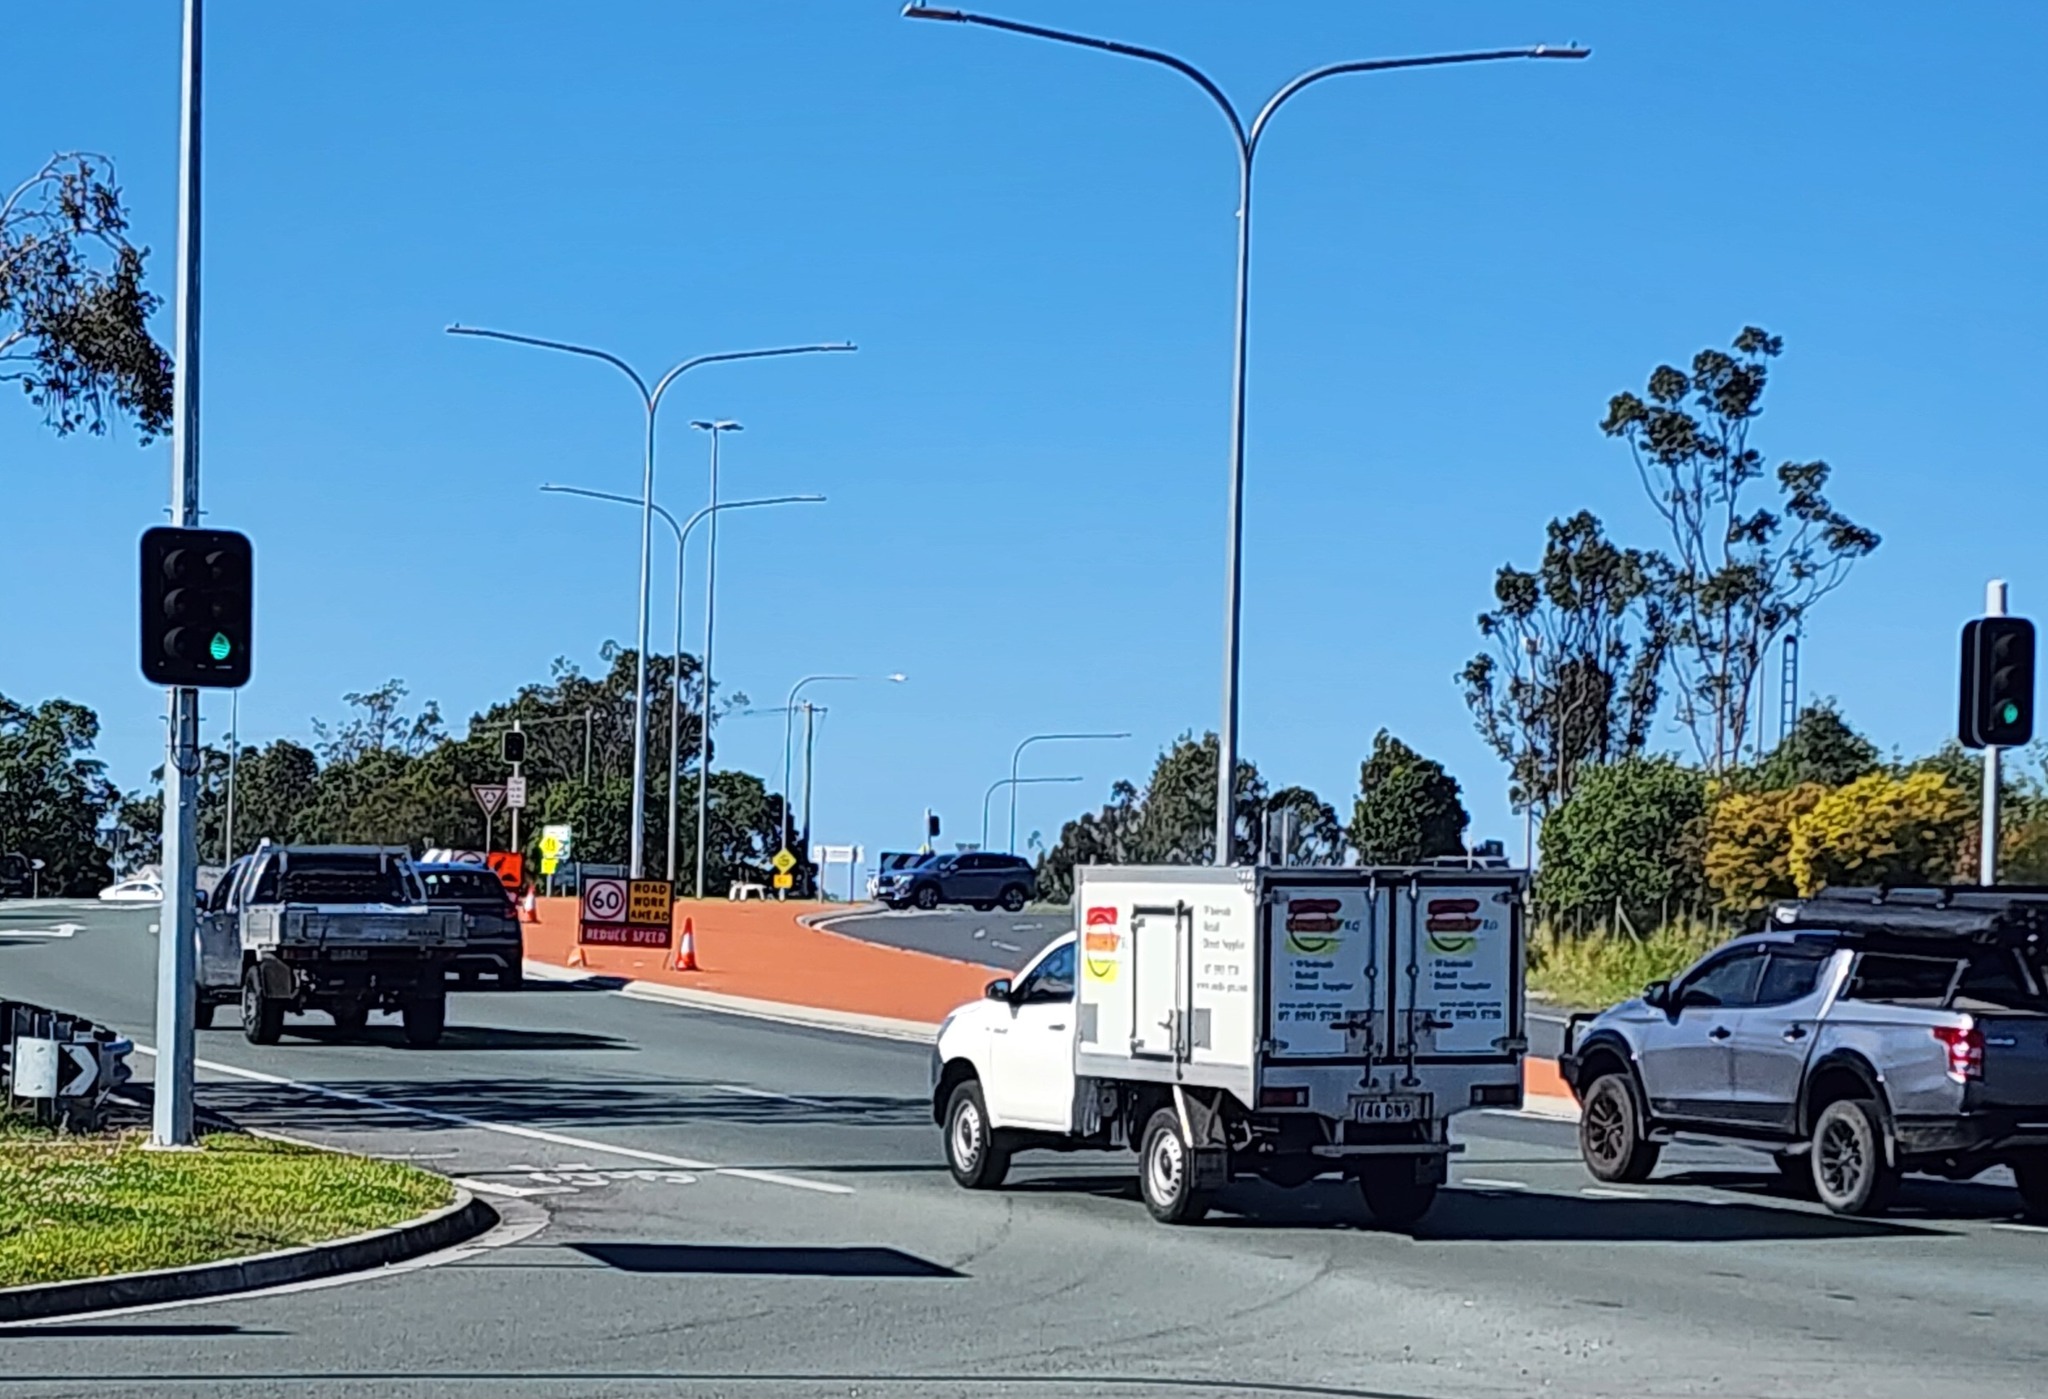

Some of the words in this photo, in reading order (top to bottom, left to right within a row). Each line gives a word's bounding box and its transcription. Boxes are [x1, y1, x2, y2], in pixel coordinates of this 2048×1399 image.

[634, 883, 667, 895] ROAD
[592, 890, 620, 910] 60
[634, 897, 665, 908] WORK
[631, 910, 669, 921] AHEAD
[586, 929, 627, 942] REDUCE
[633, 930, 666, 943] SPEED
